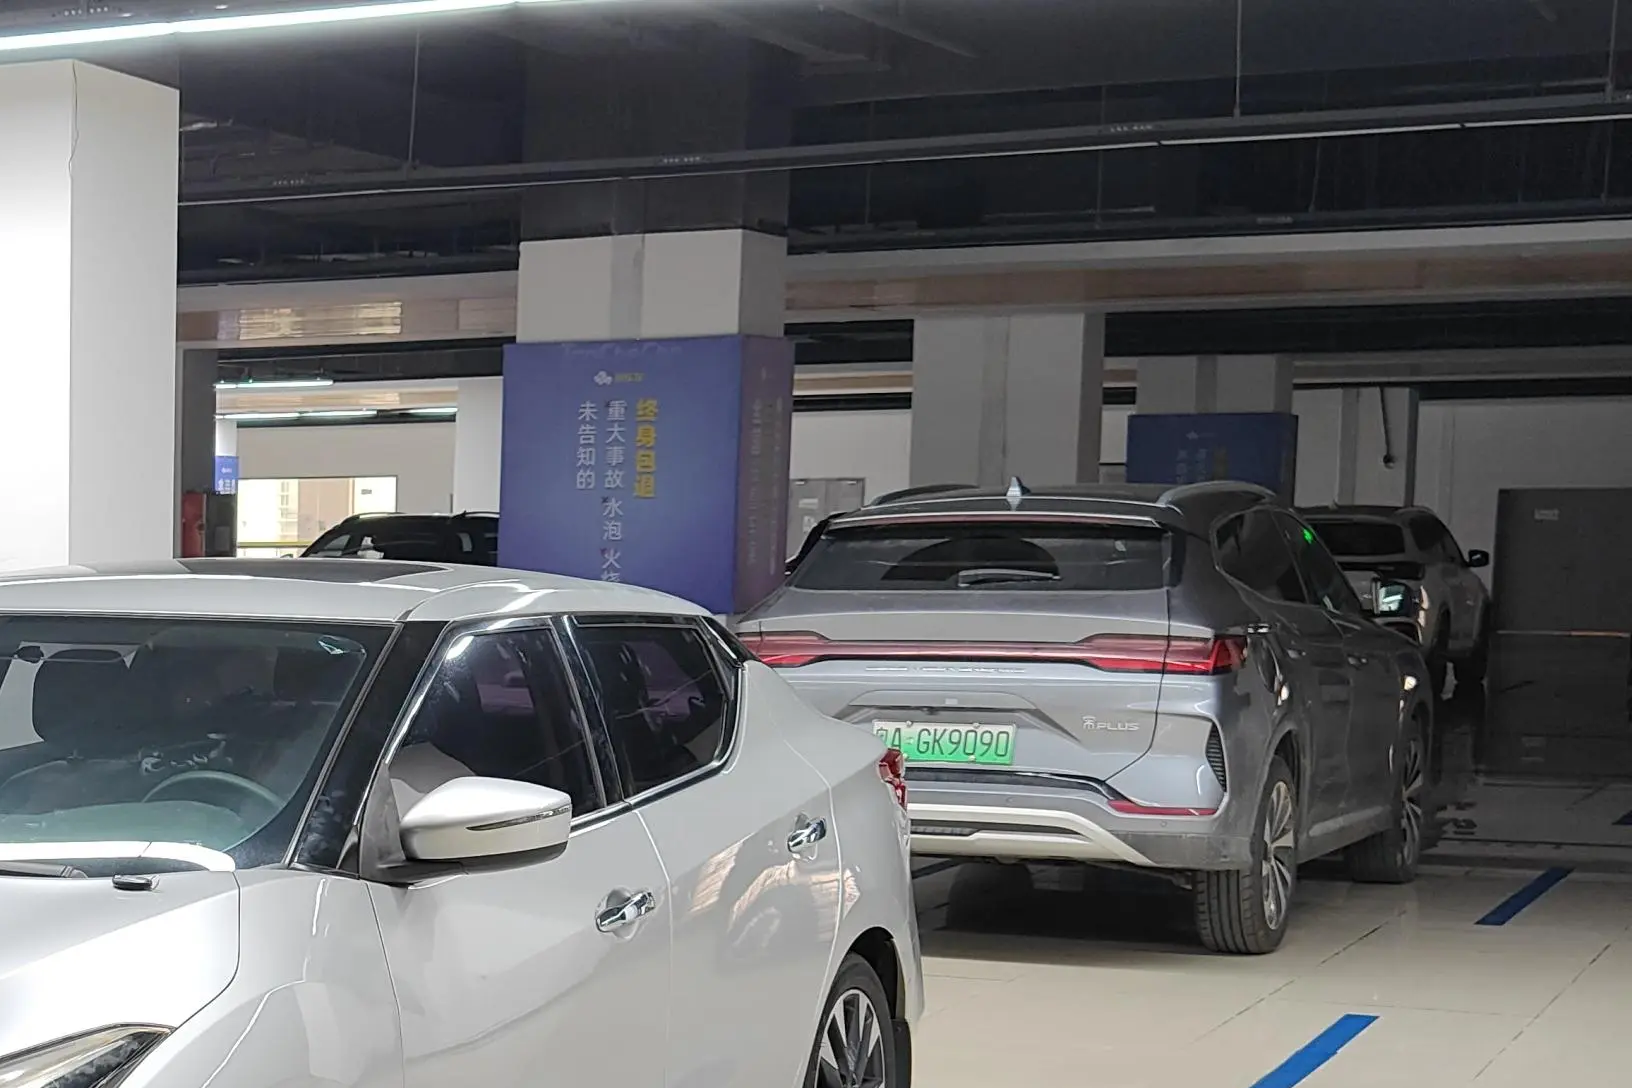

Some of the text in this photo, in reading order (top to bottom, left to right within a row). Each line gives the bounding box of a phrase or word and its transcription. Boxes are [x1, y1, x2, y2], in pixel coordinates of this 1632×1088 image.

[576, 401, 598, 490] 未告知的
[604, 400, 627, 490] 重大事故
[602, 498, 624, 541] 水泡
